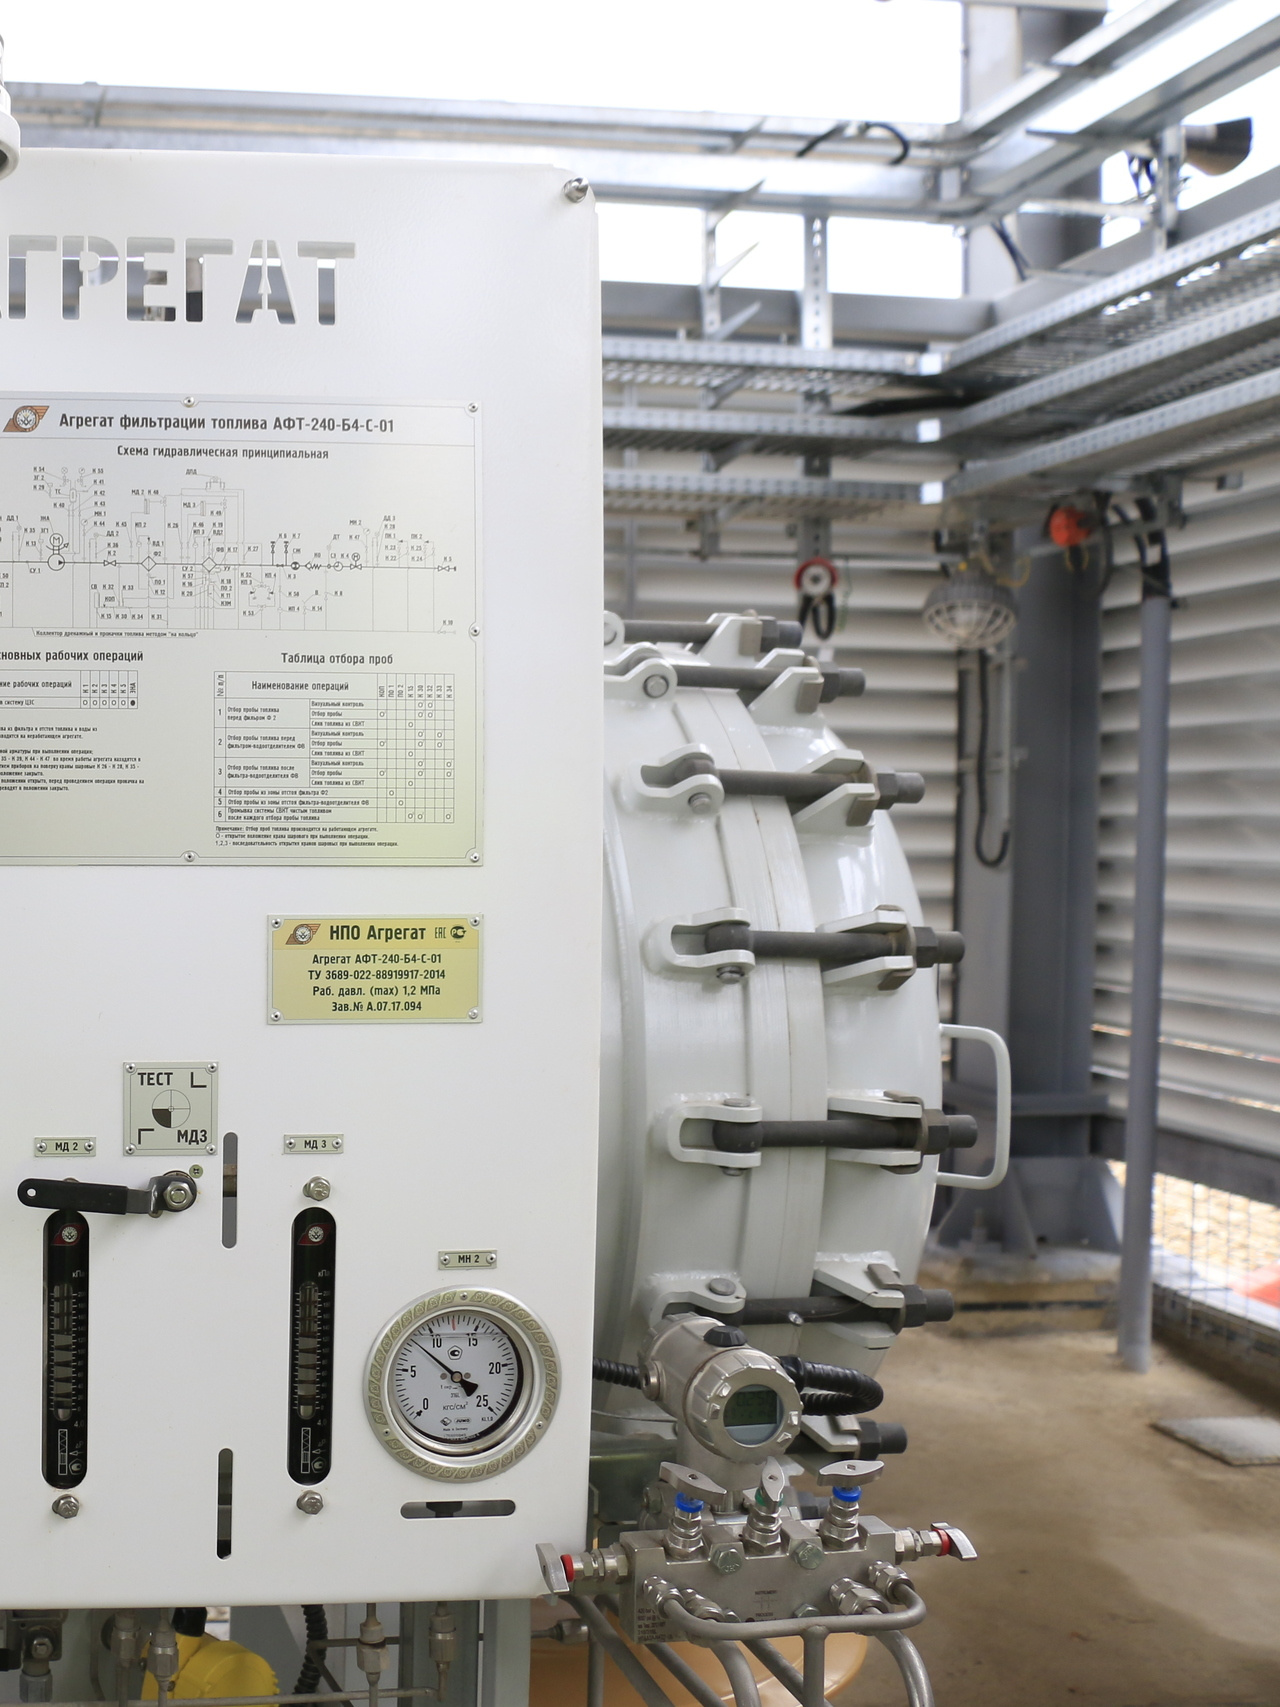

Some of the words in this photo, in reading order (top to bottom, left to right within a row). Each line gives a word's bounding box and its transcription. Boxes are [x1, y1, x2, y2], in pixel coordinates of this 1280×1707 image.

[59, 413, 114, 429] Агрегат
[120, 414, 205, 431] фильтрации
[211, 418, 267, 430] топлива
[273, 417, 393, 432] АФТ-240-Б4-С-01
[117, 445, 148, 456] Схема
[153, 448, 238, 458] гидравлическая
[242, 449, 328, 459] принципиальная
[46, 650, 88, 662] рабочих
[93, 651, 143, 662] операций
[281, 653, 325, 665] Таблица
[330, 653, 364, 665] отбора
[369, 654, 393, 666] проб
[13, 680, 39, 688] рабочих
[41, 681, 72, 689] операций
[252, 681, 308, 690] Наименование
[312, 682, 348, 692] операций
[330, 925, 360, 940] НПО
[367, 925, 426, 943] Агрегат
[312, 954, 351, 966] Агрегат
[355, 954, 441, 964] АФТ-240-Б4-С-01
[308, 970, 321, 980] ТУ
[325, 969, 445, 980] 3689-022-88919917-2014
[313, 986, 334, 996] Раб.
[338, 988, 365, 997] давл.
[370, 986, 398, 996] (max)
[403, 986, 416, 996] 1,2
[420, 985, 440, 995] МПа
[366, 1001, 422, 1011] А.07.17.094
[136, 1073, 173, 1087] ТЕСТ
[177, 1129, 208, 1145] МД3
[55, 1141, 69, 1153] МД
[72, 1141, 78, 1153] 2
[304, 1139, 318, 1151] МД
[321, 1139, 327, 1150] 3
[458, 1254, 471, 1264] МН
[474, 1254, 480, 1263] 2
[430, 1334, 442, 1348] 10
[466, 1333, 478, 1347] 15
[410, 1365, 416, 1378] 5
[489, 1362, 501, 1374] 20
[423, 1398, 429, 1410] 0
[476, 1395, 489, 1408] 25
